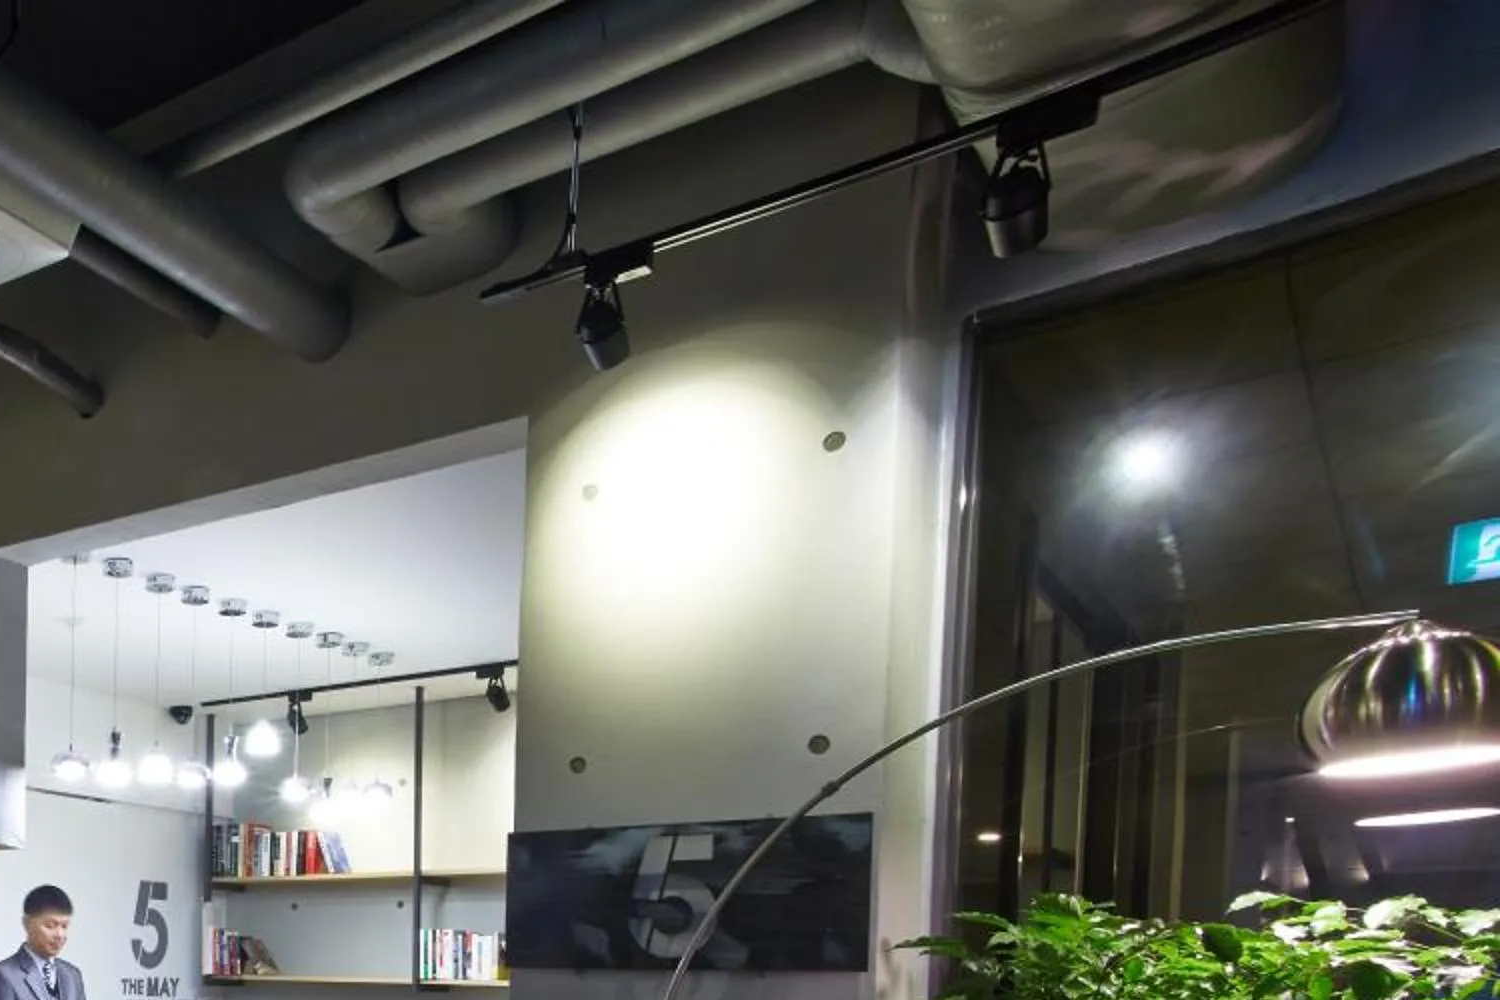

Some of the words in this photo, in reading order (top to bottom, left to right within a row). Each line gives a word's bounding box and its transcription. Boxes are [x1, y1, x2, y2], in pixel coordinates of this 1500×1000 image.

[131, 879, 169, 970] 5
[628, 832, 717, 959] 5
[121, 977, 145, 996] THE
[146, 976, 180, 998] MAY
